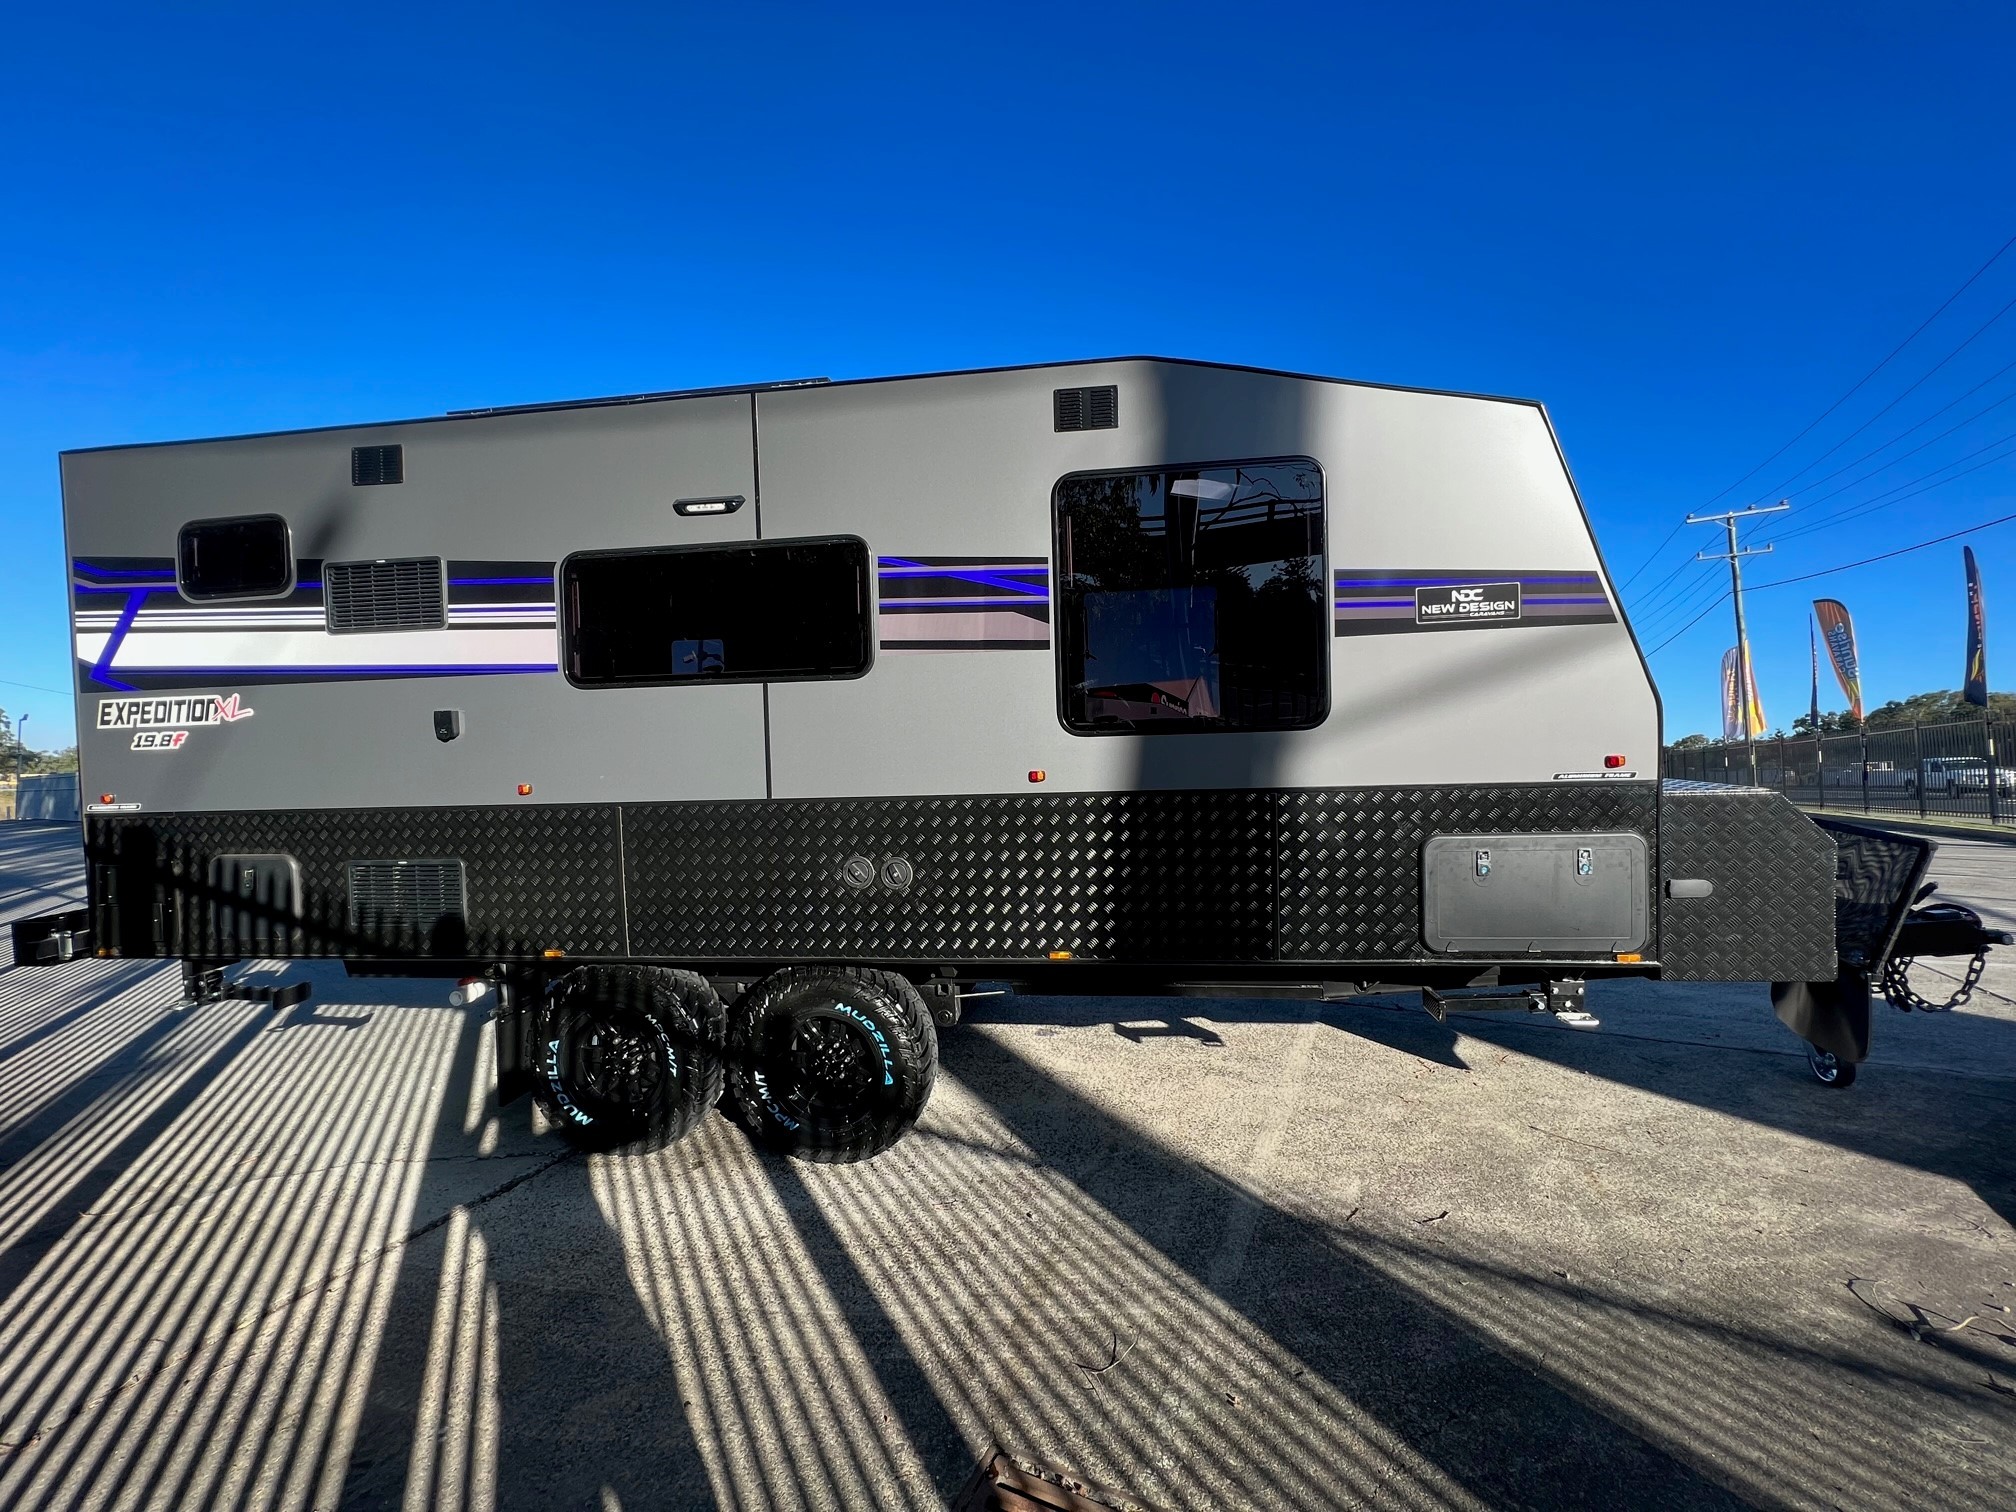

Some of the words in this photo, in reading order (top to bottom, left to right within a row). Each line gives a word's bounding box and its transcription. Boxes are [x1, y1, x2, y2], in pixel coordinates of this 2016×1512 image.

[1421, 603, 1456, 615] NEW
[1459, 600, 1515, 613] DESIGN
[1451, 588, 1484, 602] NDC
[100, 698, 219, 726] EXPEDITION
[212, 695, 253, 721] XL
[834, 1002, 894, 1085] MUDZILLA
[546, 1039, 593, 1126] MUDZILLA
